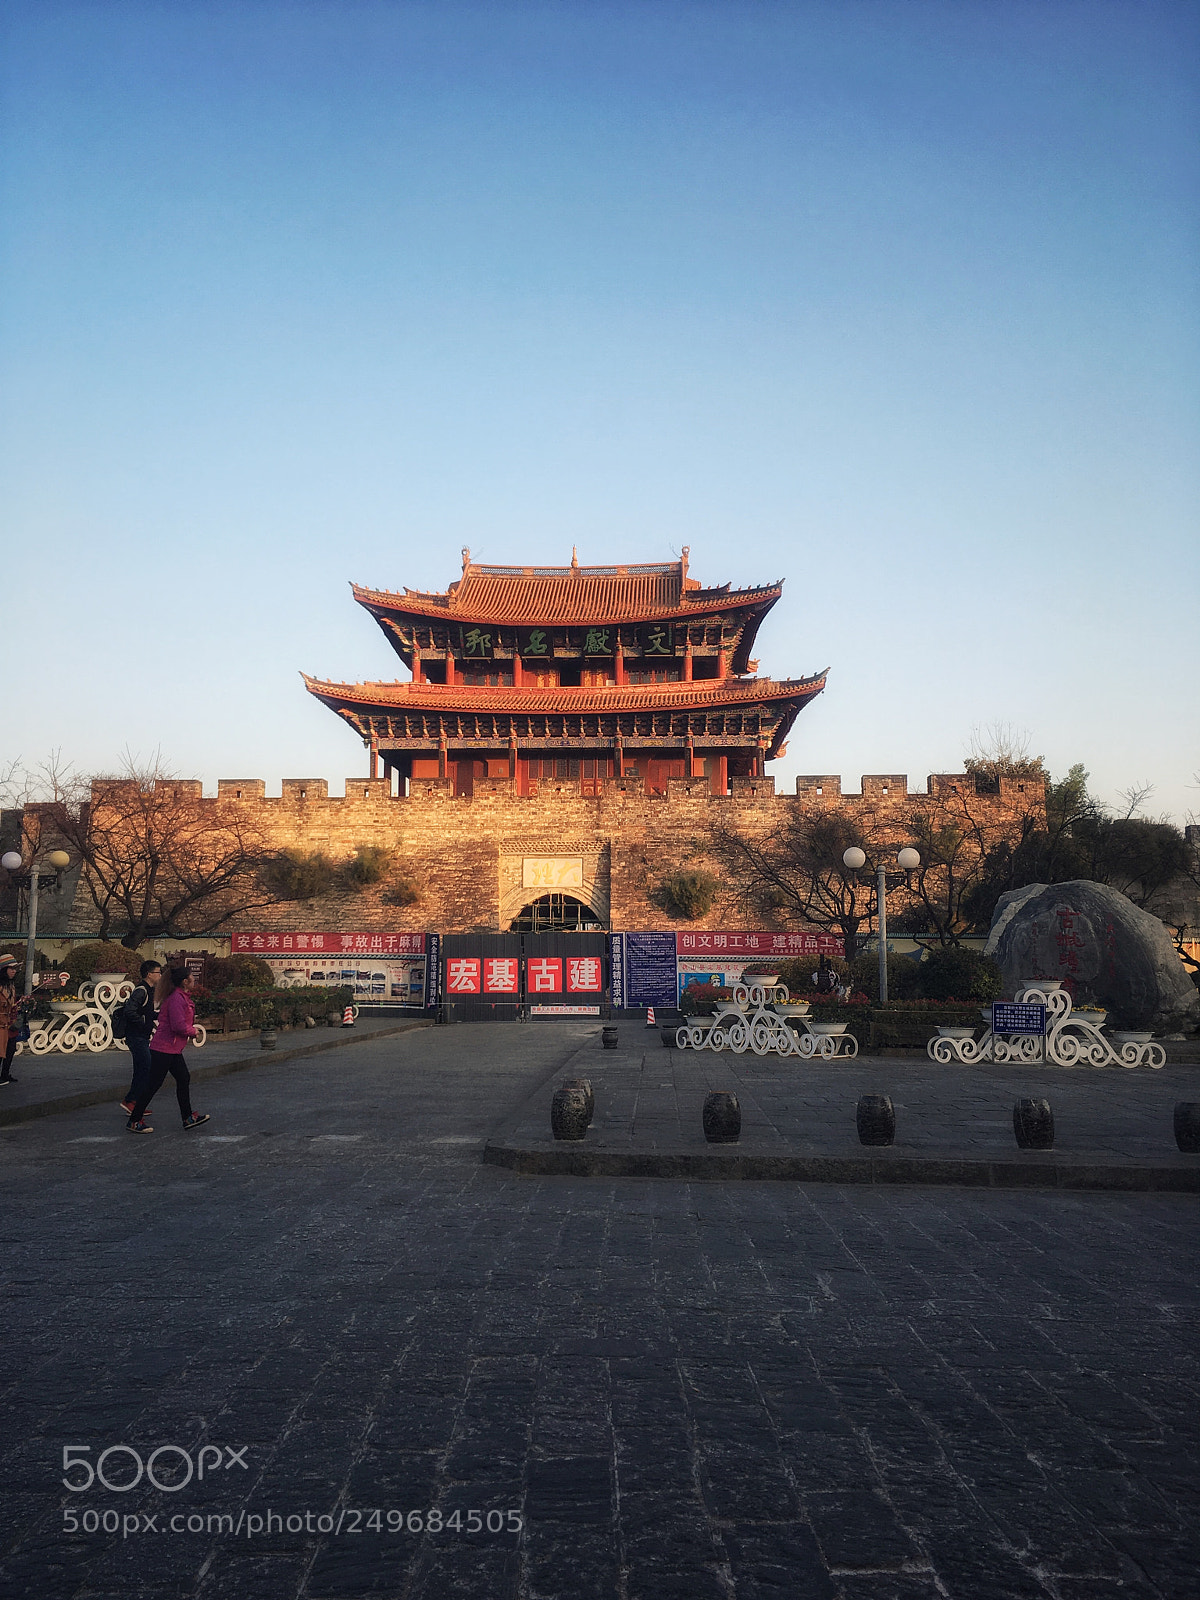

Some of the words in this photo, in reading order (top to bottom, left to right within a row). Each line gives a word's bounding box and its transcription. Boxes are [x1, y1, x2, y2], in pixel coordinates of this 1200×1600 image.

[237, 935, 325, 949] 安全来自警惕
[340, 935, 422, 948] 事故出于麻痹
[682, 934, 760, 948] 创文明工地
[450, 959, 599, 991] 宏基古建
[612, 936, 622, 1006] 质量管理精益求精
